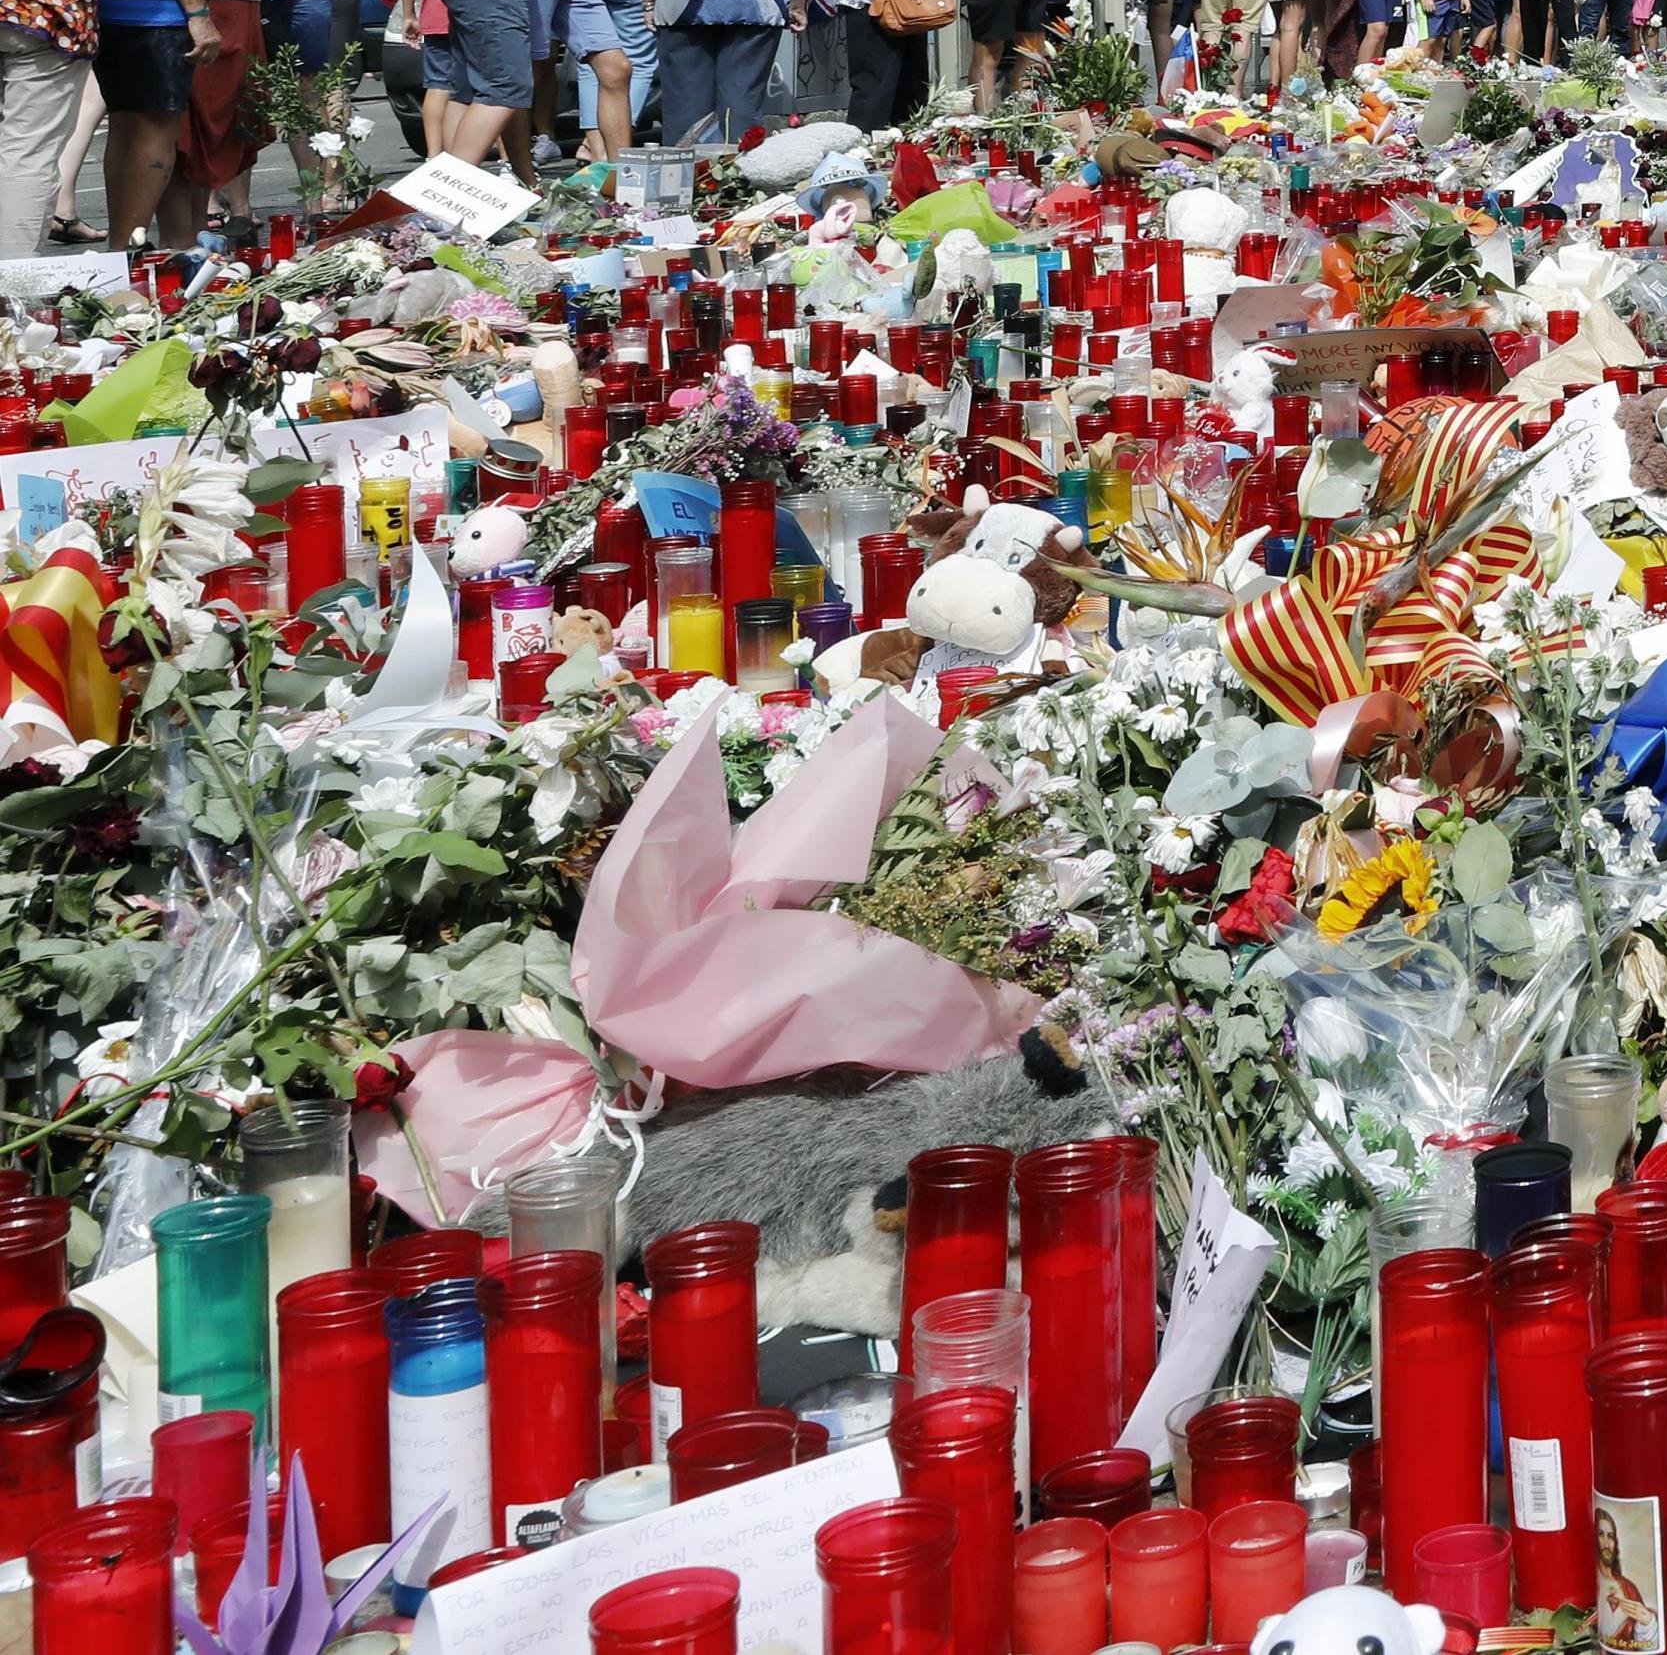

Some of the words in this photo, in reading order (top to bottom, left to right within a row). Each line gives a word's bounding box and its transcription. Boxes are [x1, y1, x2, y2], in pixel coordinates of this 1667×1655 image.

[429, 167, 509, 211] BARCELONA
[421, 186, 480, 222] ESTAMOS
[1301, 344, 1358, 363] MORE
[1363, 343, 1396, 355] ANY
[1309, 359, 1363, 375] MORE
[672, 501, 696, 520] EL
[501, 1569, 565, 1598] TODAS
[571, 1542, 615, 1571] LAS
[733, 1486, 773, 1512] DEL
[517, 1520, 561, 1536] ALTAFLAMA
[452, 1623, 487, 1646] LAS
[495, 1607, 529, 1629] QUE
[540, 1593, 565, 1613] NO
[576, 1550, 687, 1594] PUDIERON
